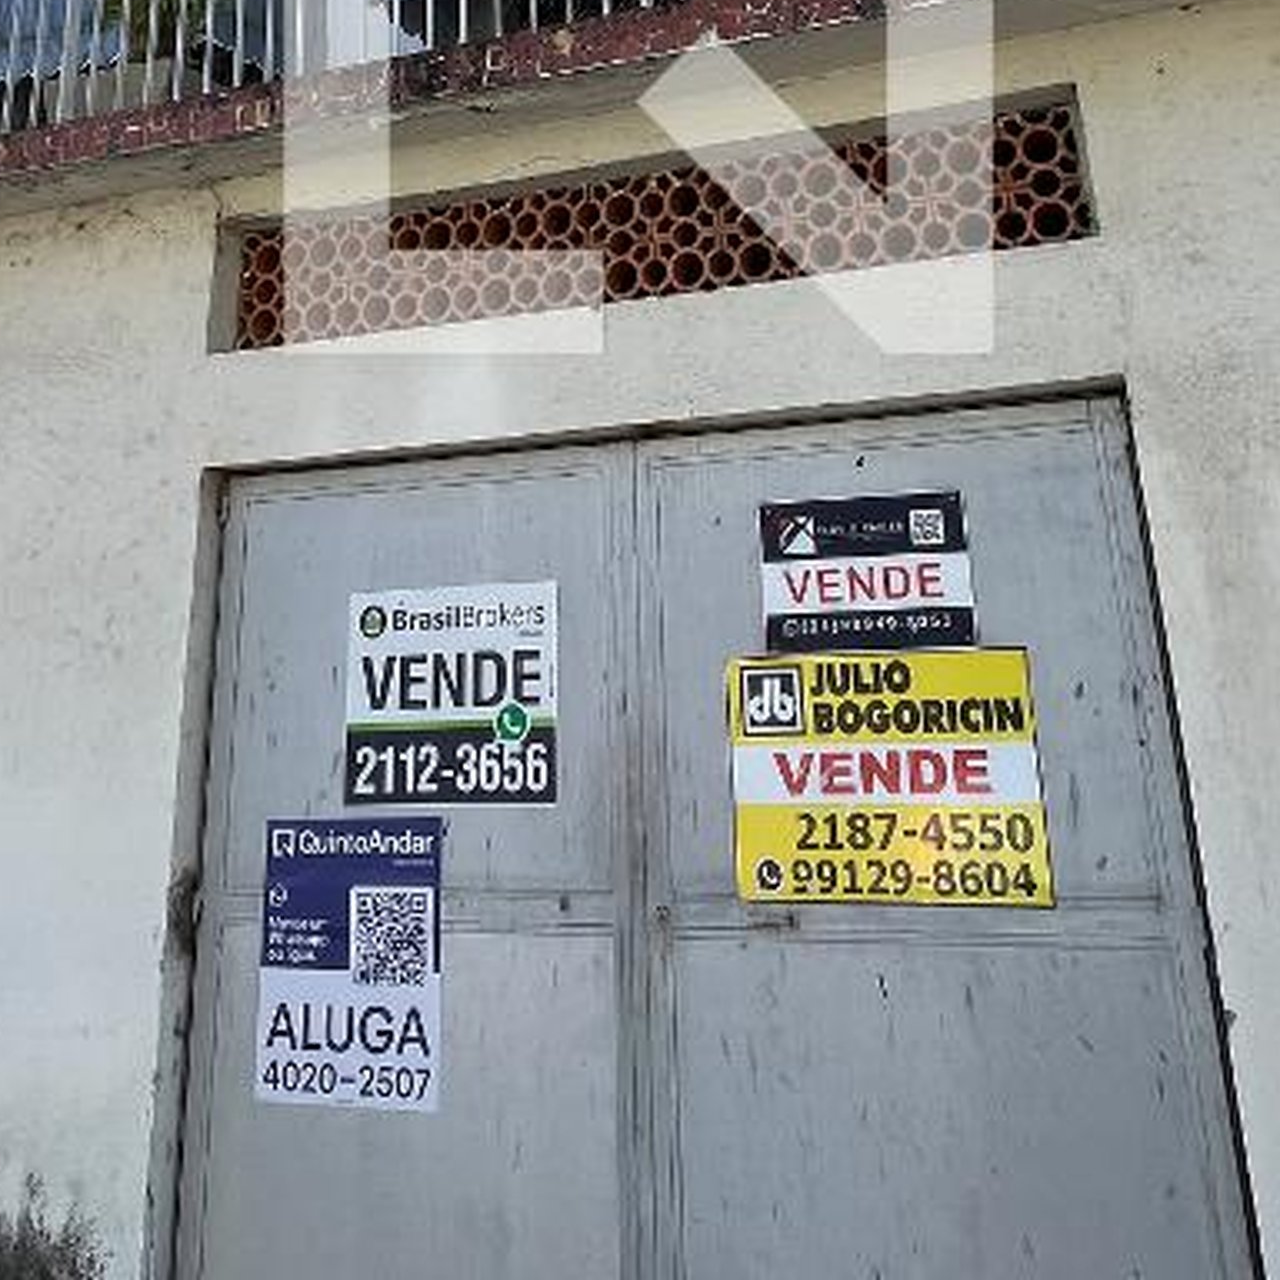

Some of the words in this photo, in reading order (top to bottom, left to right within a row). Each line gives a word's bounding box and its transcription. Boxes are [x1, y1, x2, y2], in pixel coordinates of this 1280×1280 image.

[784, 562, 944, 604] VENDE
[362, 650, 541, 710] VENDE
[811, 660, 910, 696] JULIO
[813, 697, 1024, 734] BOGORICIN
[353, 742, 547, 795] 2112-3656
[772, 749, 991, 796] VENDE
[299, 829, 435, 855] QuintoAndar
[796, 813, 1035, 852] 2187-4550
[792, 860, 1038, 898] 99129-8604
[266, 1002, 430, 1057] ALUGA
[263, 1060, 431, 1100] 4020-2507
